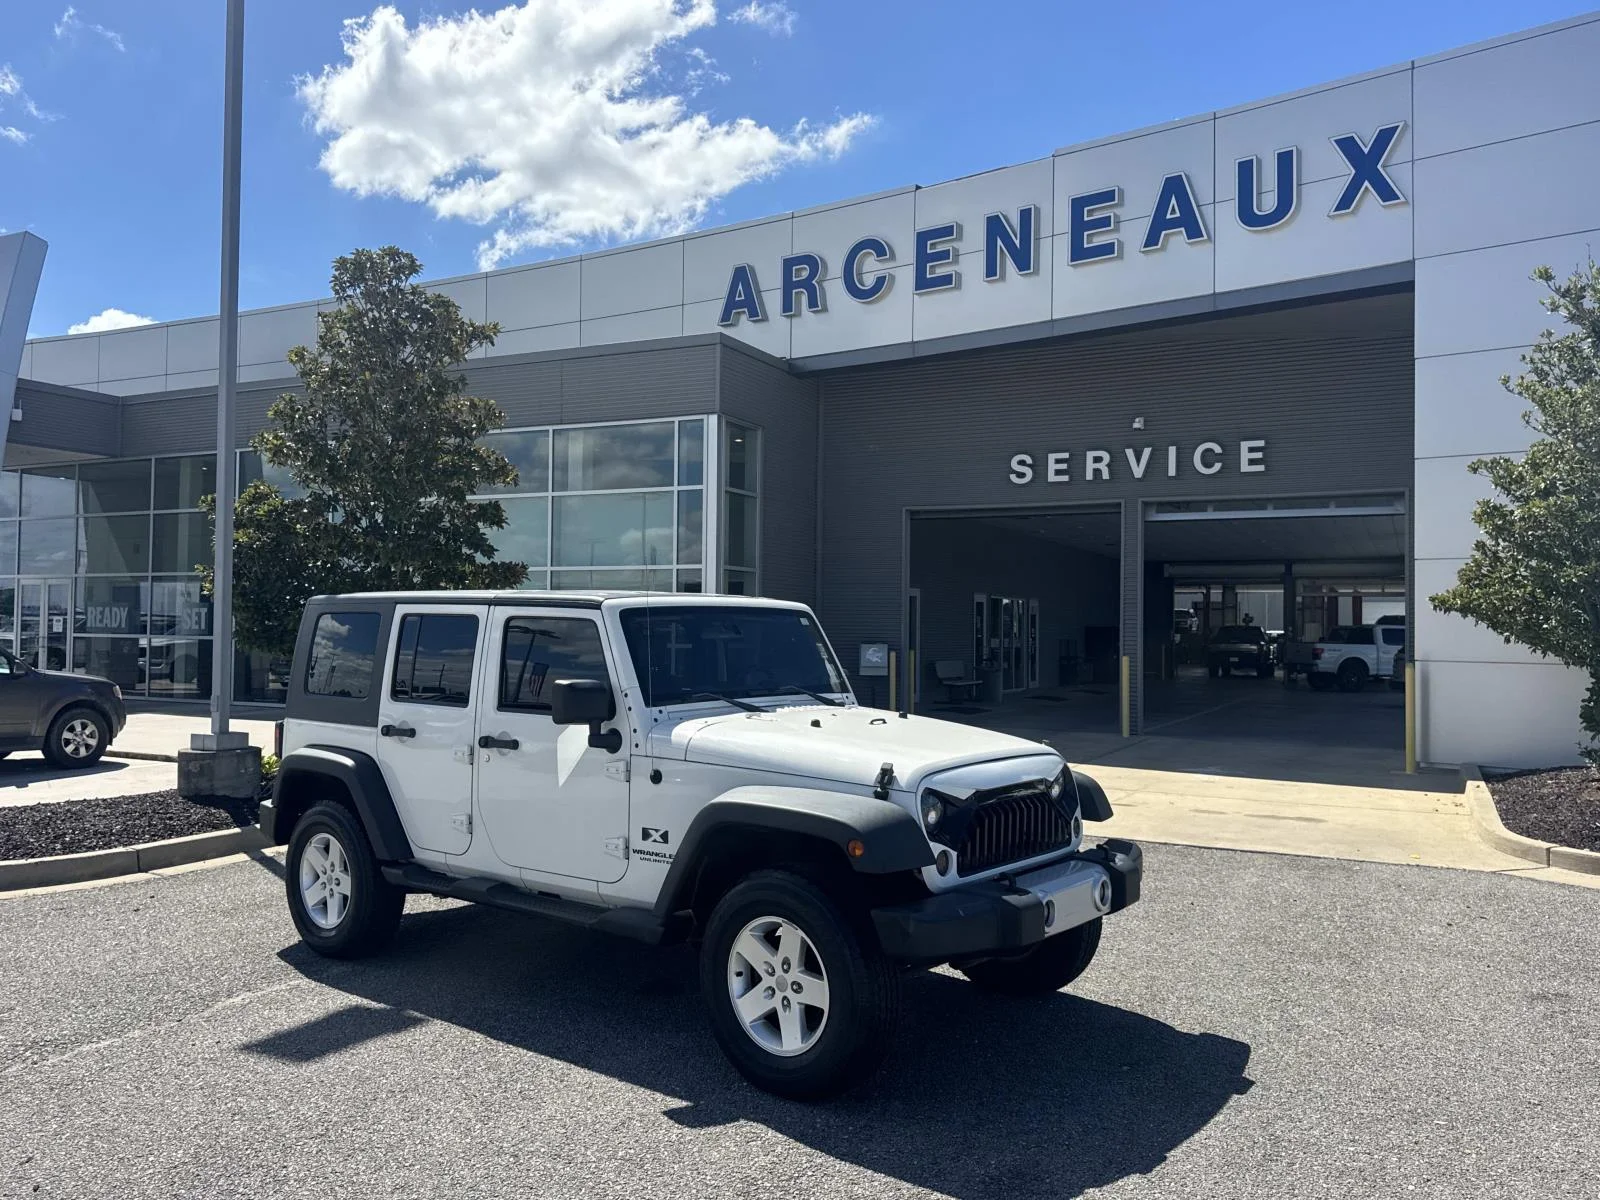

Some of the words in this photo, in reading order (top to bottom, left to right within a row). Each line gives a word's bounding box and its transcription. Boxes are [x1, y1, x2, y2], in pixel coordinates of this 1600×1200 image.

[718, 120, 1408, 327] ARCENEAUX
[1009, 438, 1267, 486] SERVICE
[86, 606, 129, 629] READY
[181, 607, 208, 631] SET
[645, 828, 667, 844] X
[632, 848, 675, 860] WRANGLE
[639, 856, 672, 865] UNLIMITE
